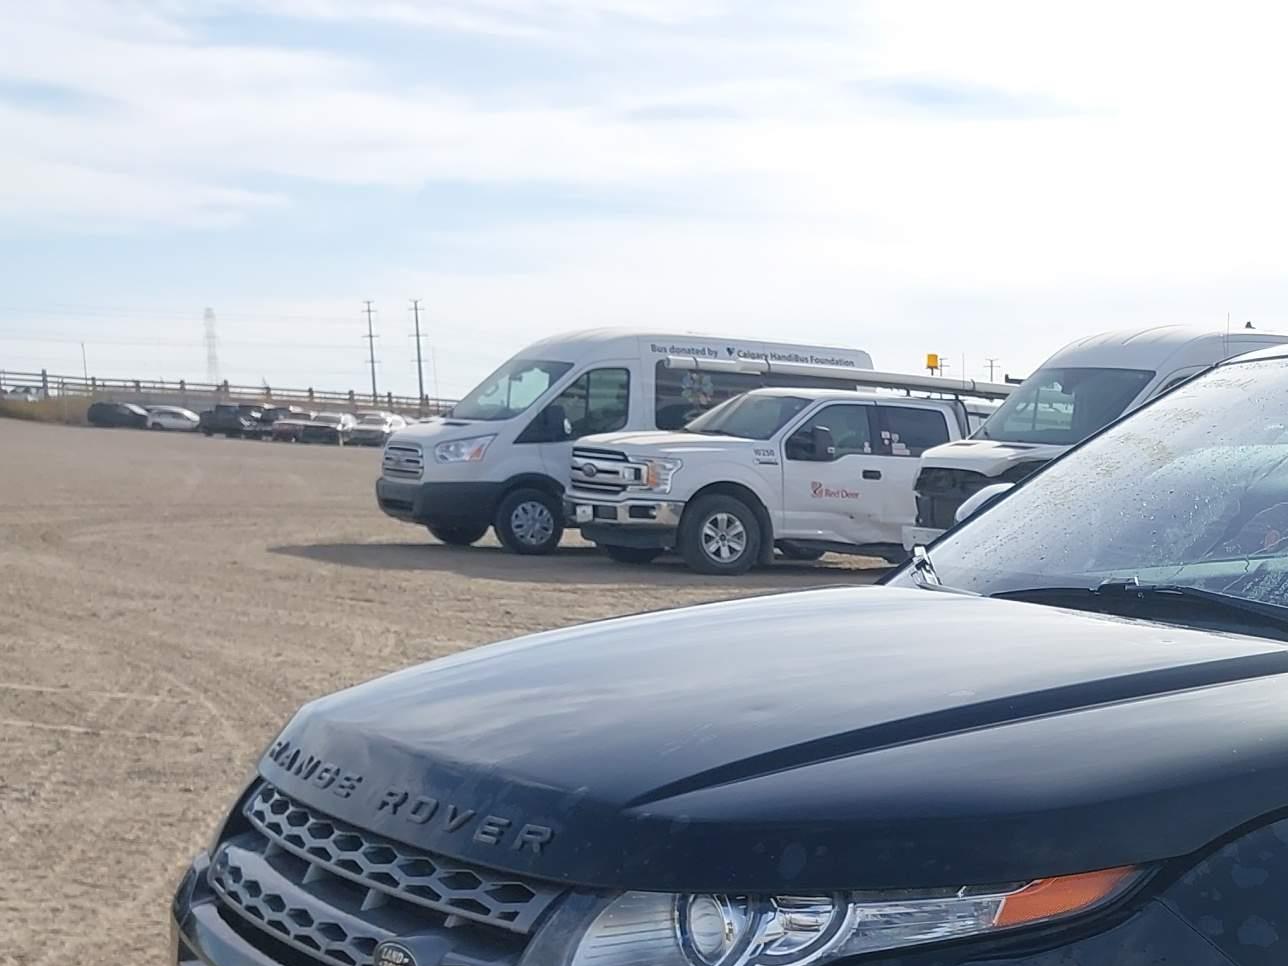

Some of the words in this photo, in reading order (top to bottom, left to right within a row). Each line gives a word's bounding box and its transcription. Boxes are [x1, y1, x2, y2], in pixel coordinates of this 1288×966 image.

[651, 344, 668, 353] Bus
[669, 346, 706, 356] donated
[707, 346, 719, 358] by
[737, 349, 769, 360] Calgary
[810, 355, 855, 367] Foundation
[824, 488, 840, 498] Red
[841, 489, 860, 499] Deer
[268, 741, 364, 800] RANGE
[377, 785, 554, 855] ROVER
